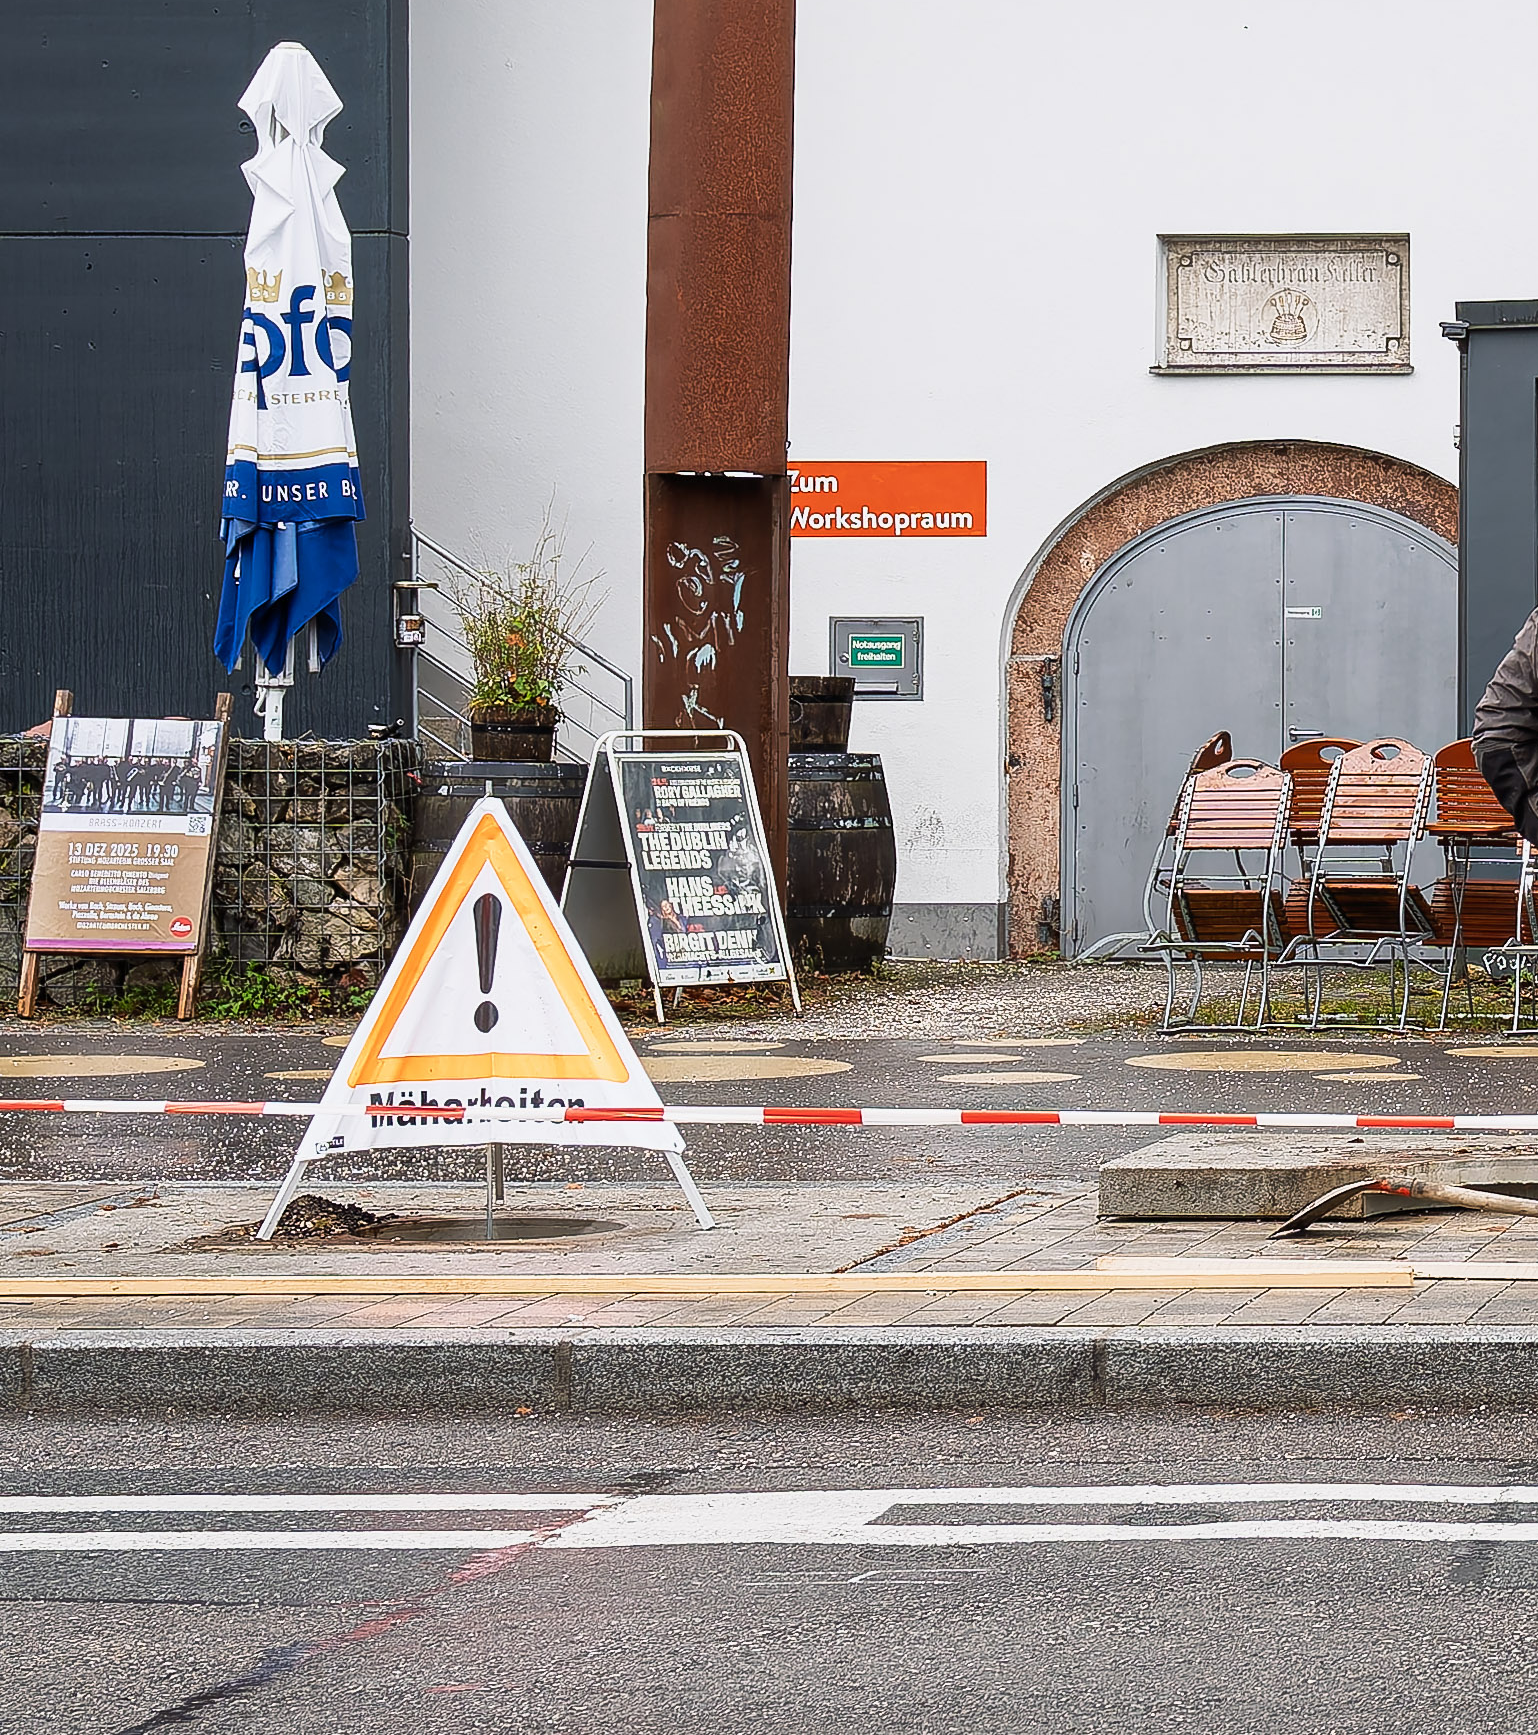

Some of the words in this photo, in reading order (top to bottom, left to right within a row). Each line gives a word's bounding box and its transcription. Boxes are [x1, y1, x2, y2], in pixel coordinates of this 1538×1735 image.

[787, 469, 838, 493] Zum
[261, 481, 330, 502] UNSER
[790, 506, 973, 536] Workshopraum
[852, 639, 902, 651] Notausgang
[857, 651, 896, 662] freihalten
[654, 784, 682, 798] RORY
[682, 784, 743, 799] GALLAGHER
[68, 842, 83, 856] 13
[86, 843, 107, 856] DEZ
[110, 843, 139, 857] 2025
[146, 844, 179, 858] 19.30
[638, 832, 671, 850] THE
[671, 831, 729, 850] DUBLIN
[641, 850, 713, 870] LEGENDS
[665, 876, 714, 897] HANS
[662, 932, 715, 953] BIRGIT
